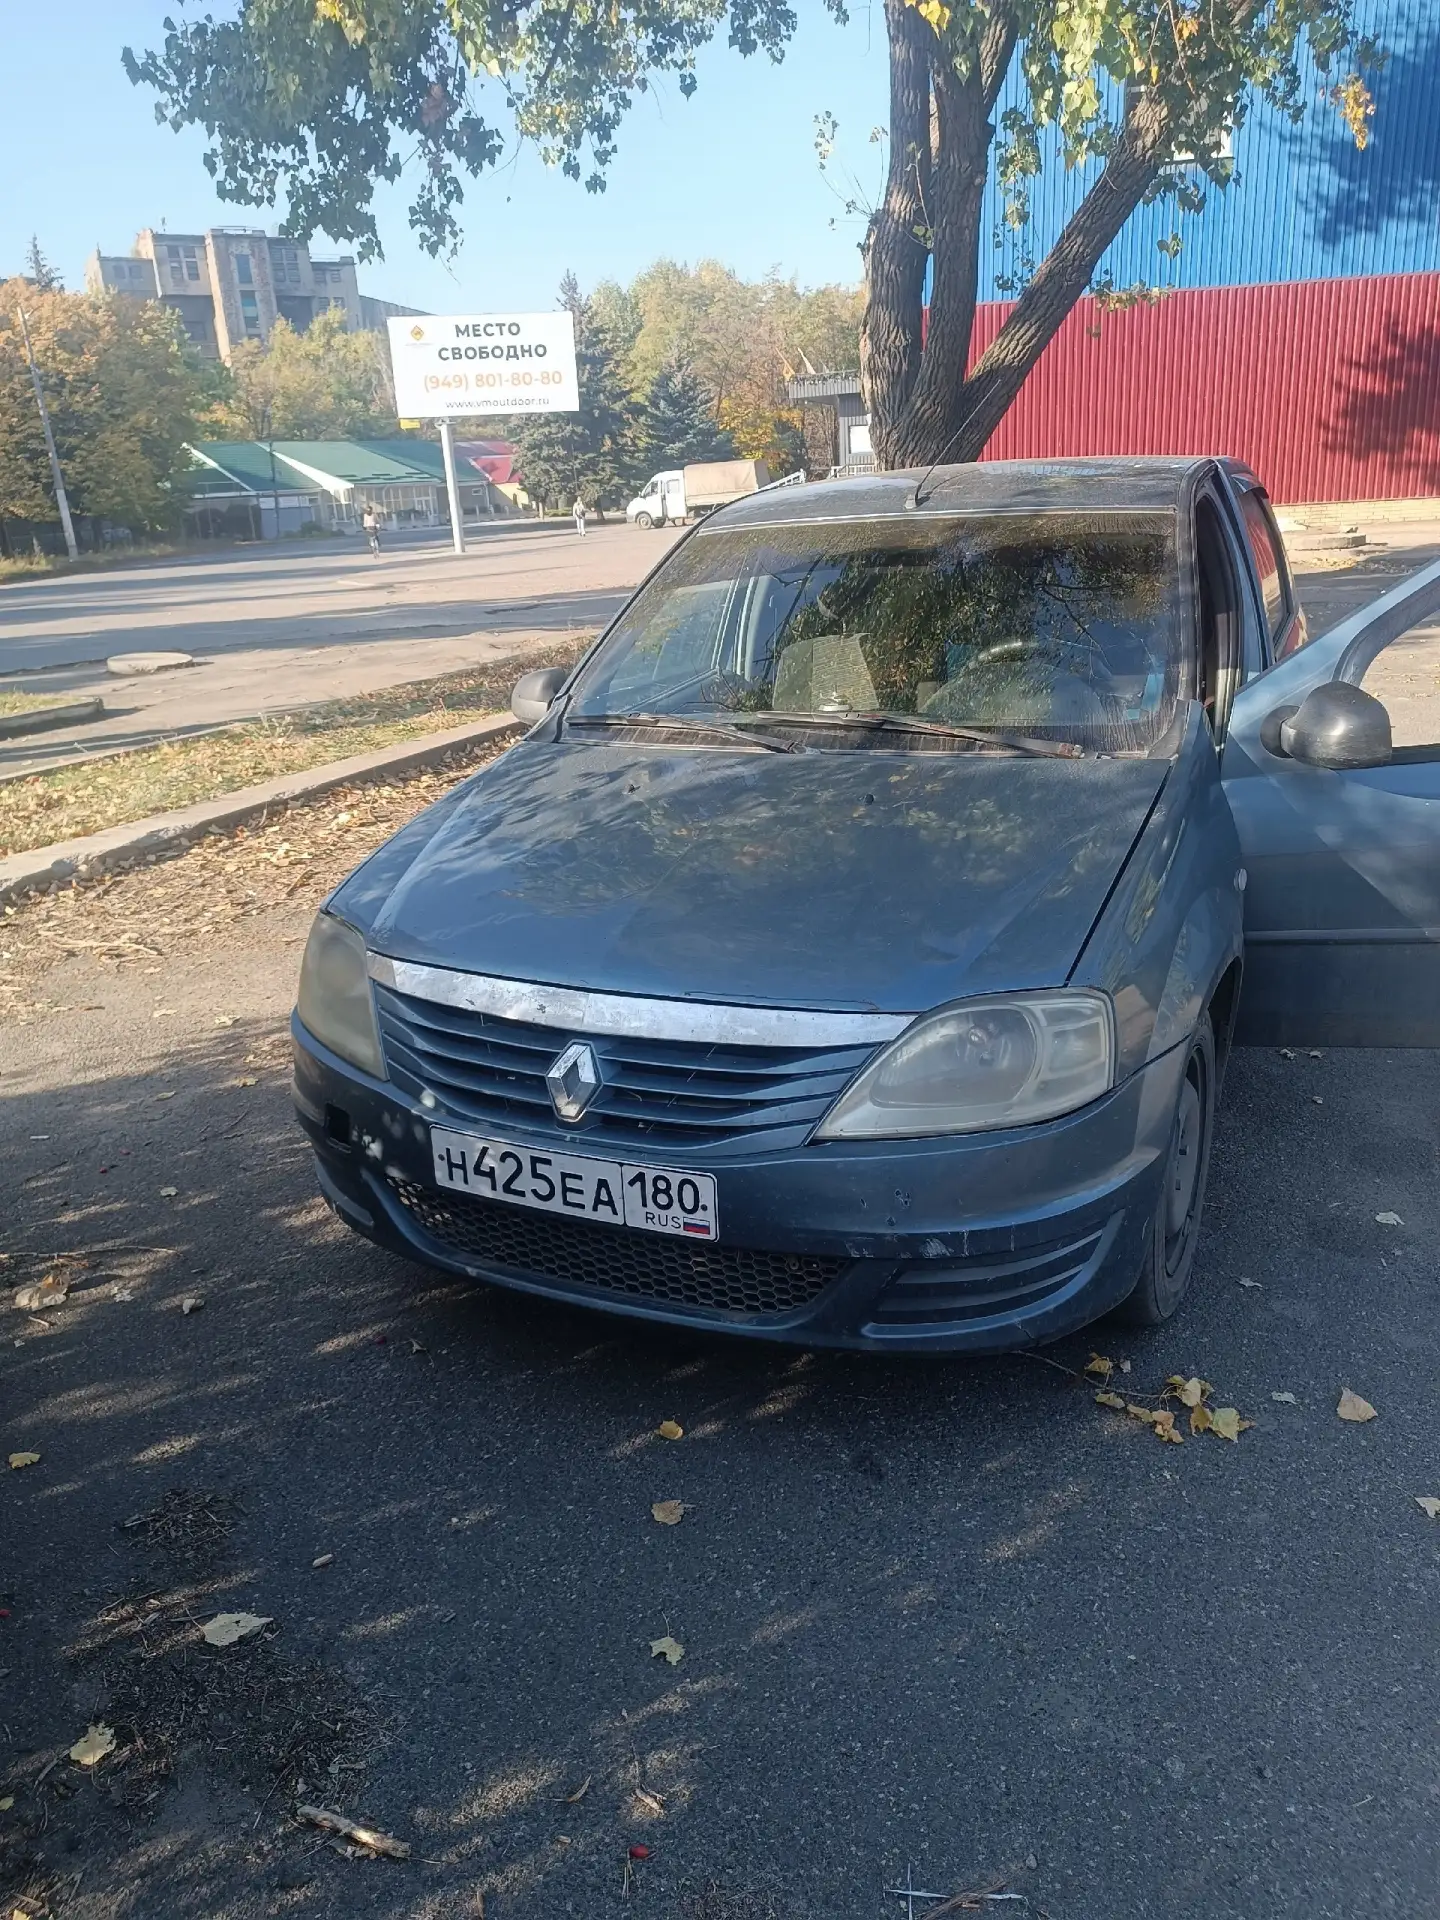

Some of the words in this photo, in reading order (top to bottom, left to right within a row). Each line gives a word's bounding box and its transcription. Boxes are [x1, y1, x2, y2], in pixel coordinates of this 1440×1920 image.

[455, 322, 521, 338] МЕСТО
[438, 344, 548, 361] СВОБОДНО
[424, 374, 469, 393] (949)
[475, 371, 563, 388] 801-80-80
[445, 396, 550, 409] www.vmoutdoor.ru
[627, 1171, 700, 1215] 180
[645, 1211, 682, 1229] RUS
